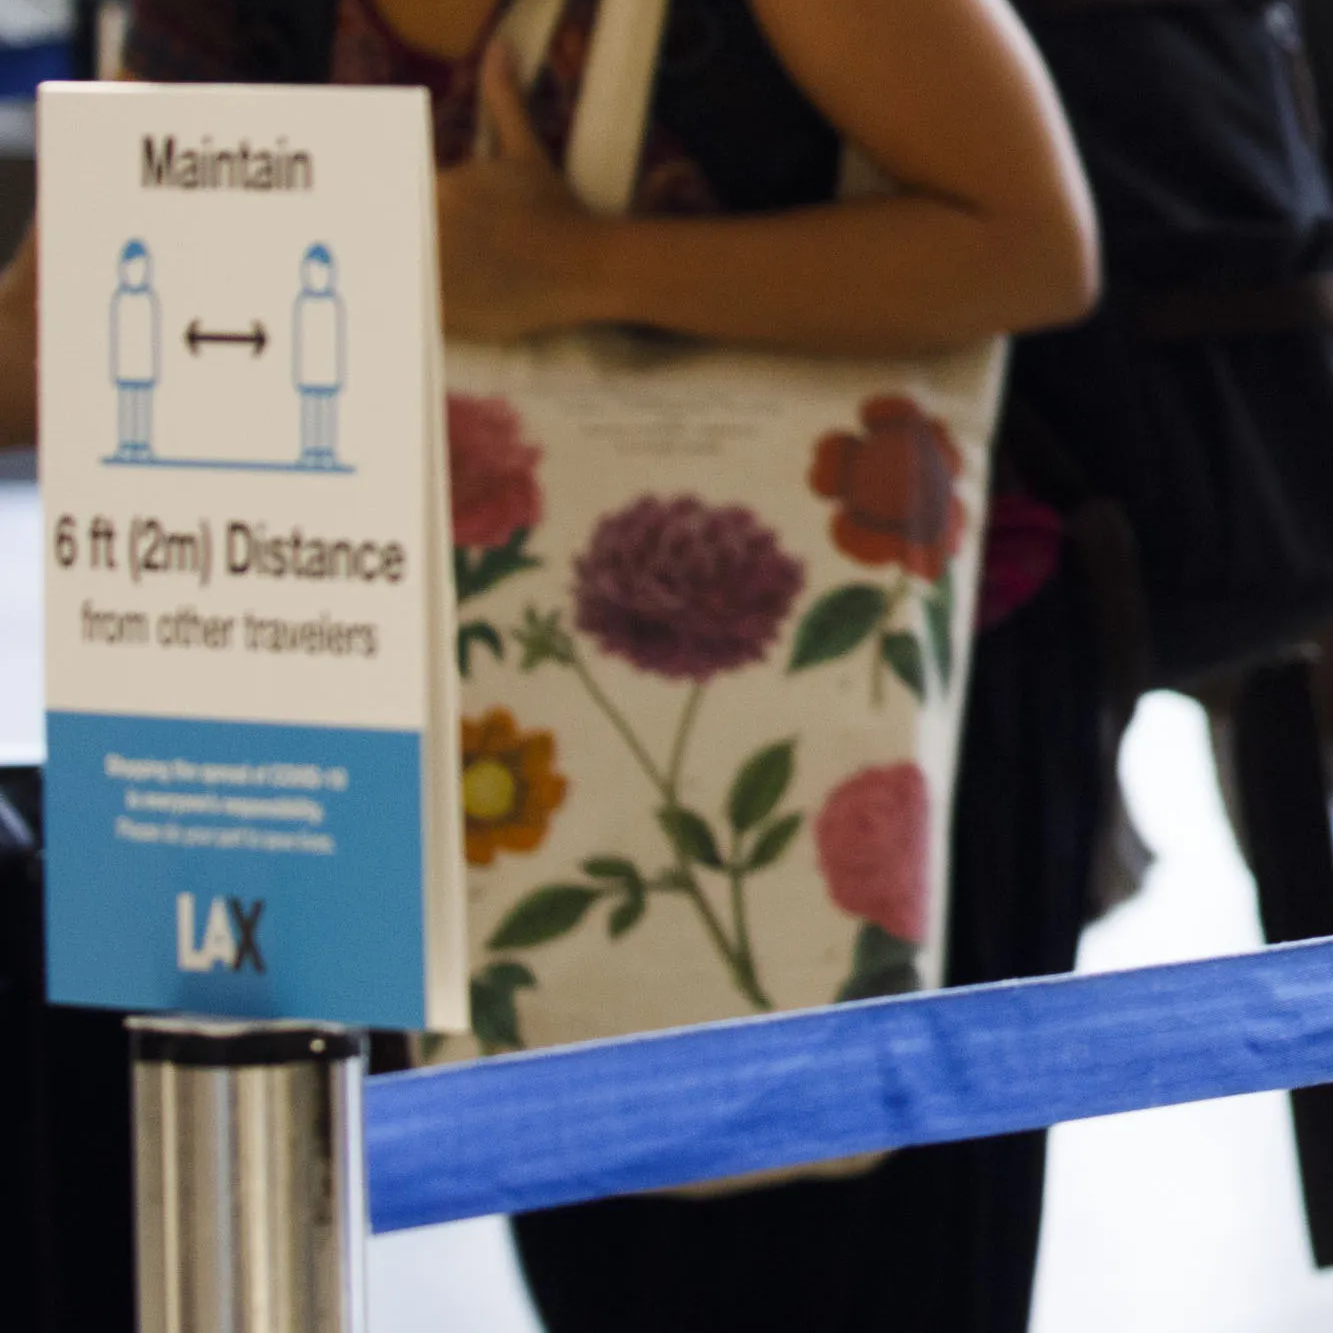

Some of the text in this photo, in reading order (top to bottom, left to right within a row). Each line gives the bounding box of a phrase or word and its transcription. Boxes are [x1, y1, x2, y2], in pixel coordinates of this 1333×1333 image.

[140, 133, 314, 191] Maintain
[54, 514, 406, 586] 6 ft (2m) Distance
[80, 598, 380, 658] from other travelers
[176, 890, 267, 975] LAX
